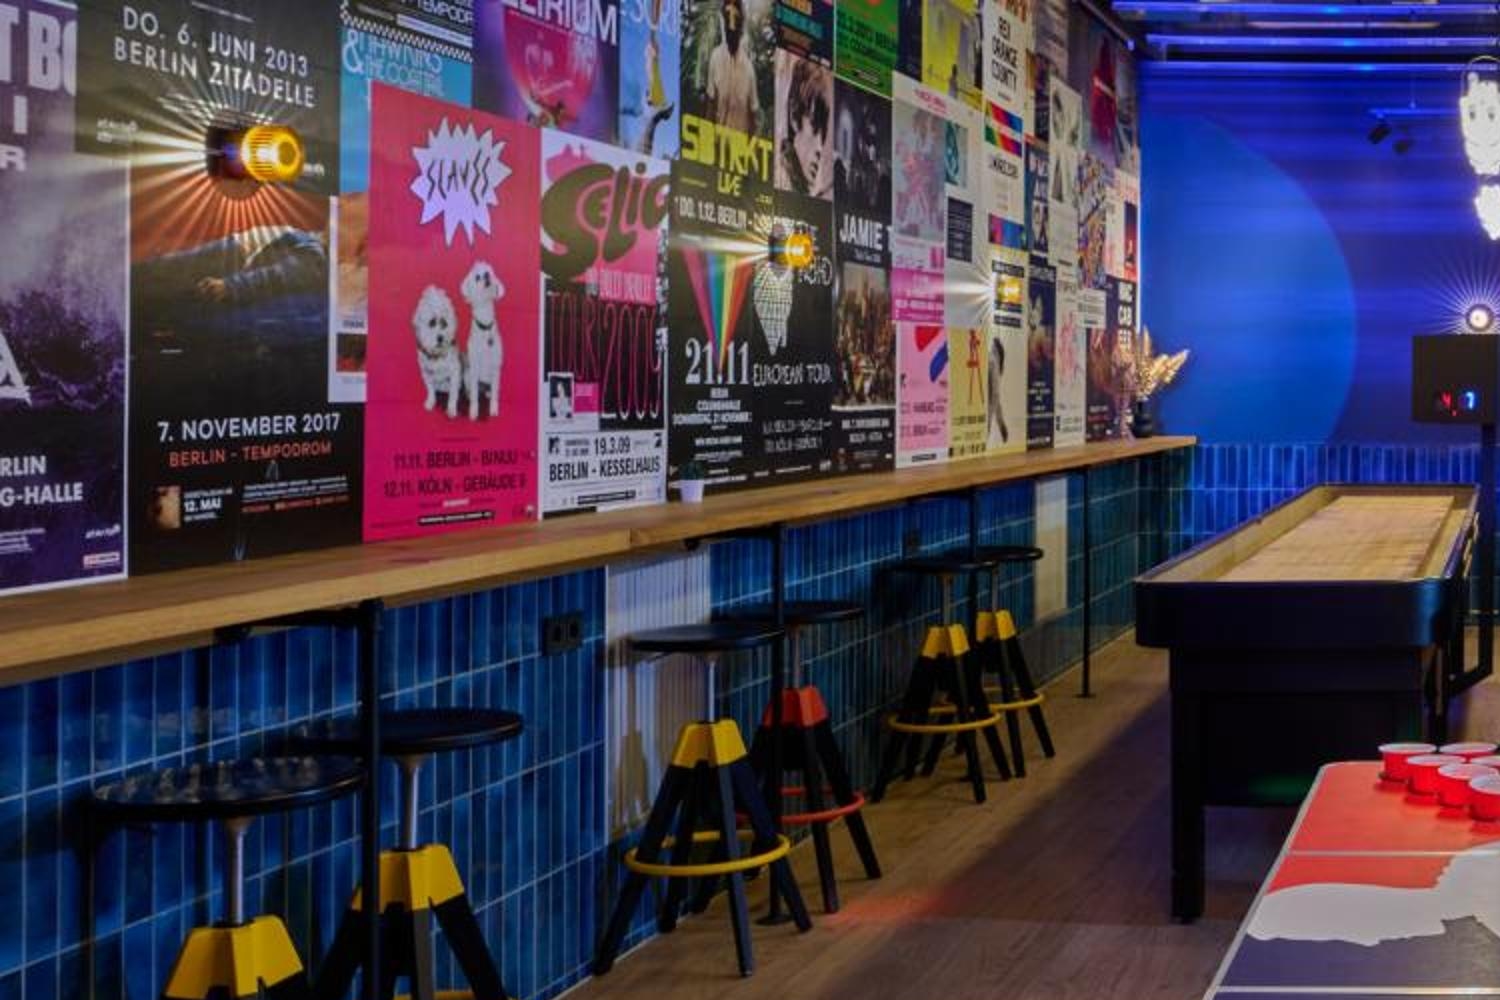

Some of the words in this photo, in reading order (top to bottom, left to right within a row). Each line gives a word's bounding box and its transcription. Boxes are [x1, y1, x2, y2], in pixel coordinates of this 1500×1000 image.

[123, 5, 166, 40] DO.
[177, 22, 198, 49] 6.
[208, 31, 256, 63] JUNI
[265, 46, 309, 78] 2013
[114, 36, 198, 80] BERLIN
[208, 61, 316, 108] ZITADELLE
[839, 213, 882, 251] JAMIE
[158, 421, 173, 442] 7.
[182, 416, 296, 441] NOVEMBER
[303, 413, 341, 433] 2017
[169, 449, 225, 468] BERLIN
[243, 440, 332, 461] TEMPODROM
[549, 461, 589, 482] BERLIN
[599, 456, 661, 477] KESSELHAUS
